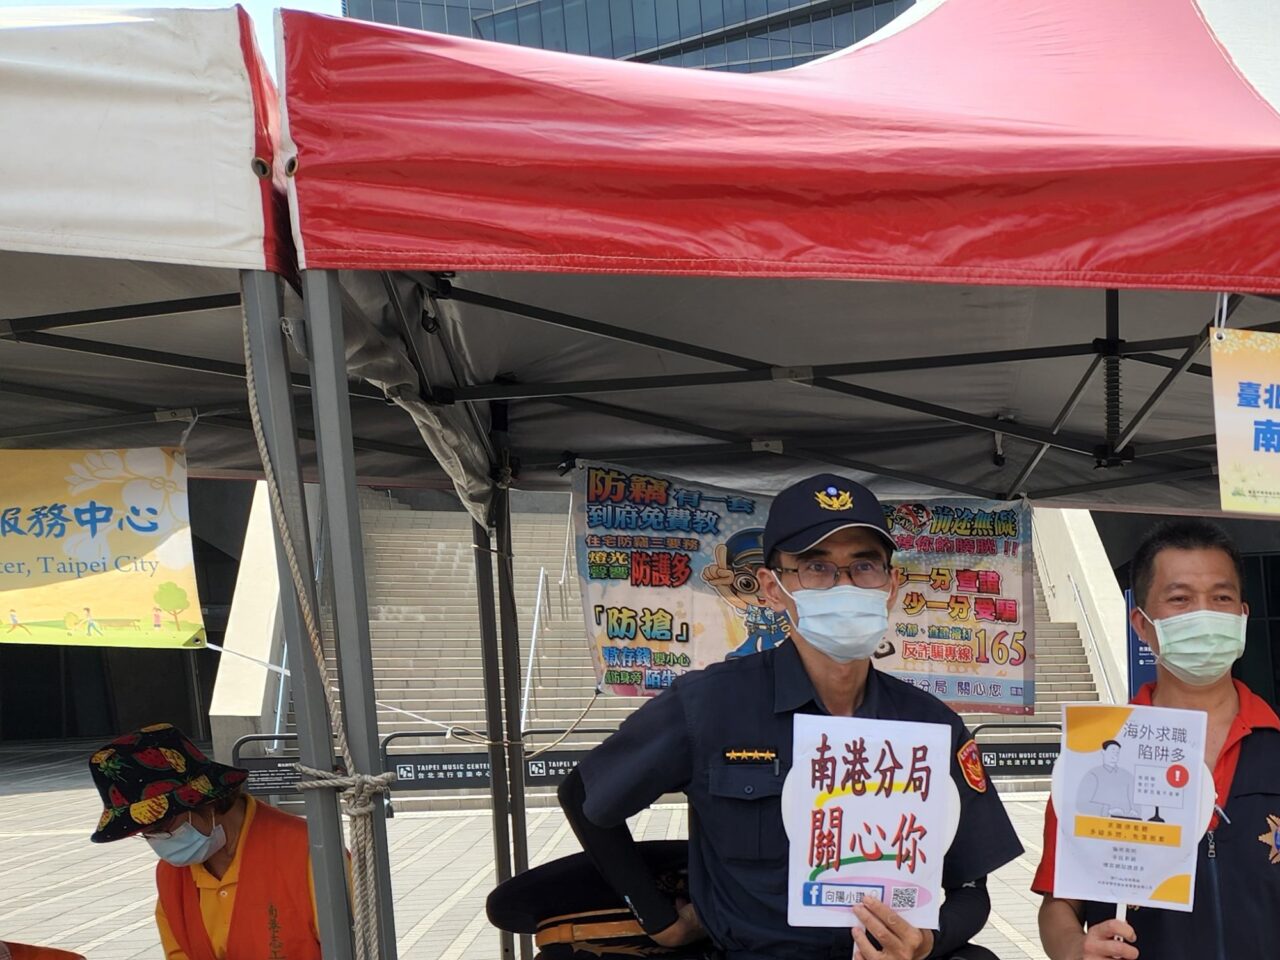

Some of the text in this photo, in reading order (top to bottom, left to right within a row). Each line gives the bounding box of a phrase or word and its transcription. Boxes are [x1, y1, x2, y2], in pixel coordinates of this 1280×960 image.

[587, 467, 670, 506] 防竊
[587, 505, 720, 536] 到府免費教
[37, 557, 106, 577] Taipei
[115, 556, 159, 577] City
[630, 551, 692, 588] 防護多
[903, 591, 971, 620] 少一分
[776, 615, 790, 634] 110
[902, 640, 973, 663] 反詐騙專線
[975, 629, 1027, 666] 165
[1123, 722, 1188, 744] 海外求職
[810, 732, 932, 802] 南港分局
[1138, 744, 1186, 763] 陷阱多
[807, 806, 927, 873] 關心你
